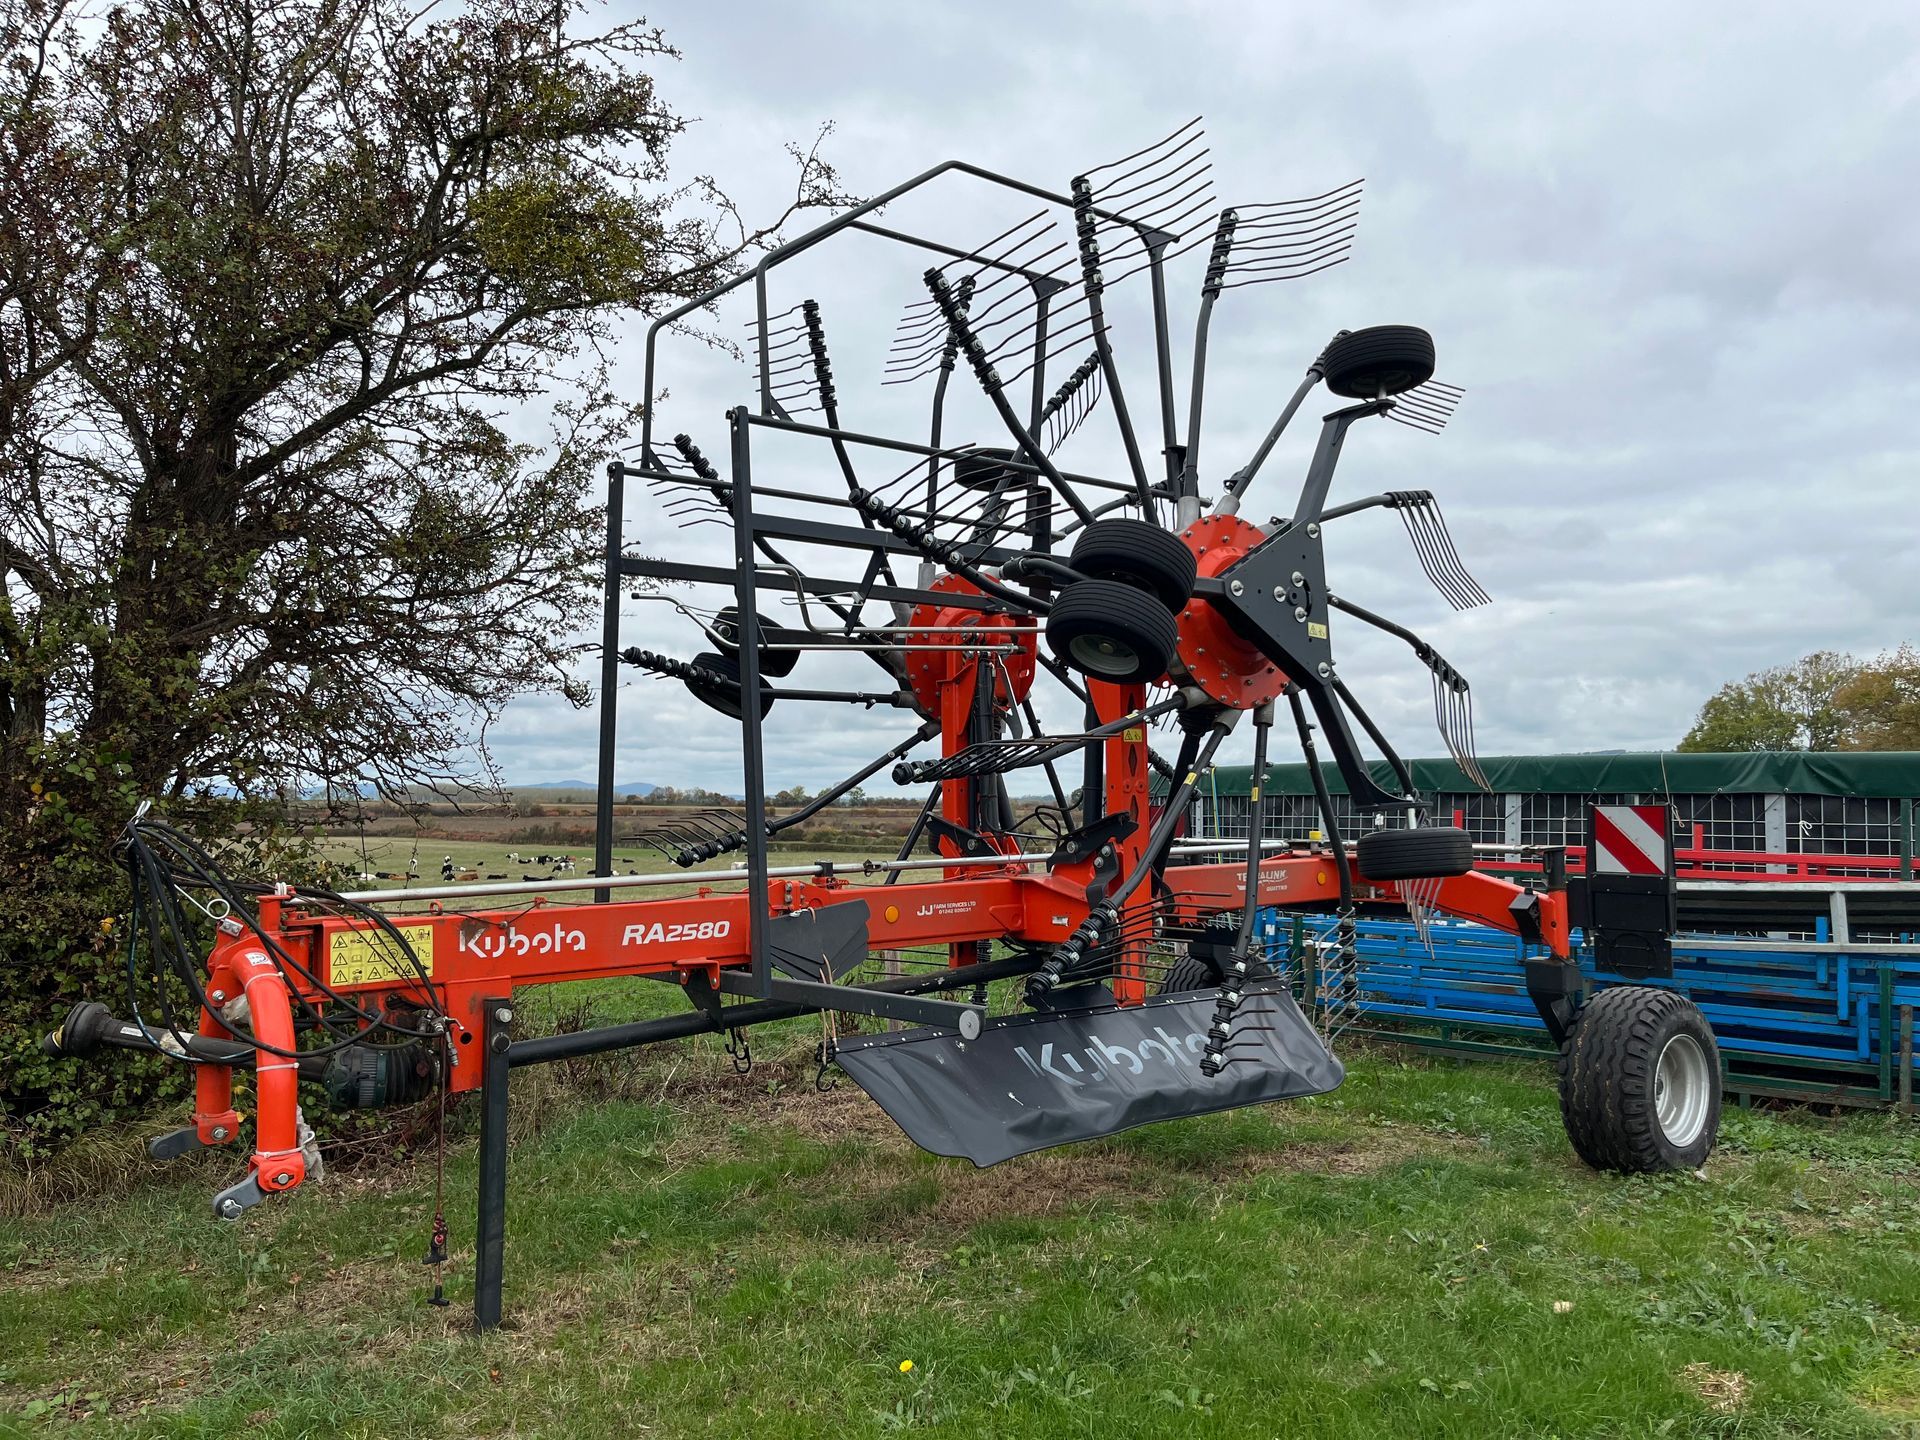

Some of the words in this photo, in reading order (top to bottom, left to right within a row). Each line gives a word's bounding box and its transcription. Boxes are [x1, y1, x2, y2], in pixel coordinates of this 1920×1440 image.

[1236, 870, 1287, 882] TEALINK
[916, 904, 933, 916] JJ
[946, 901, 967, 909] SERVICES
[459, 923, 586, 958] Kubota
[621, 920, 730, 946] RA2580
